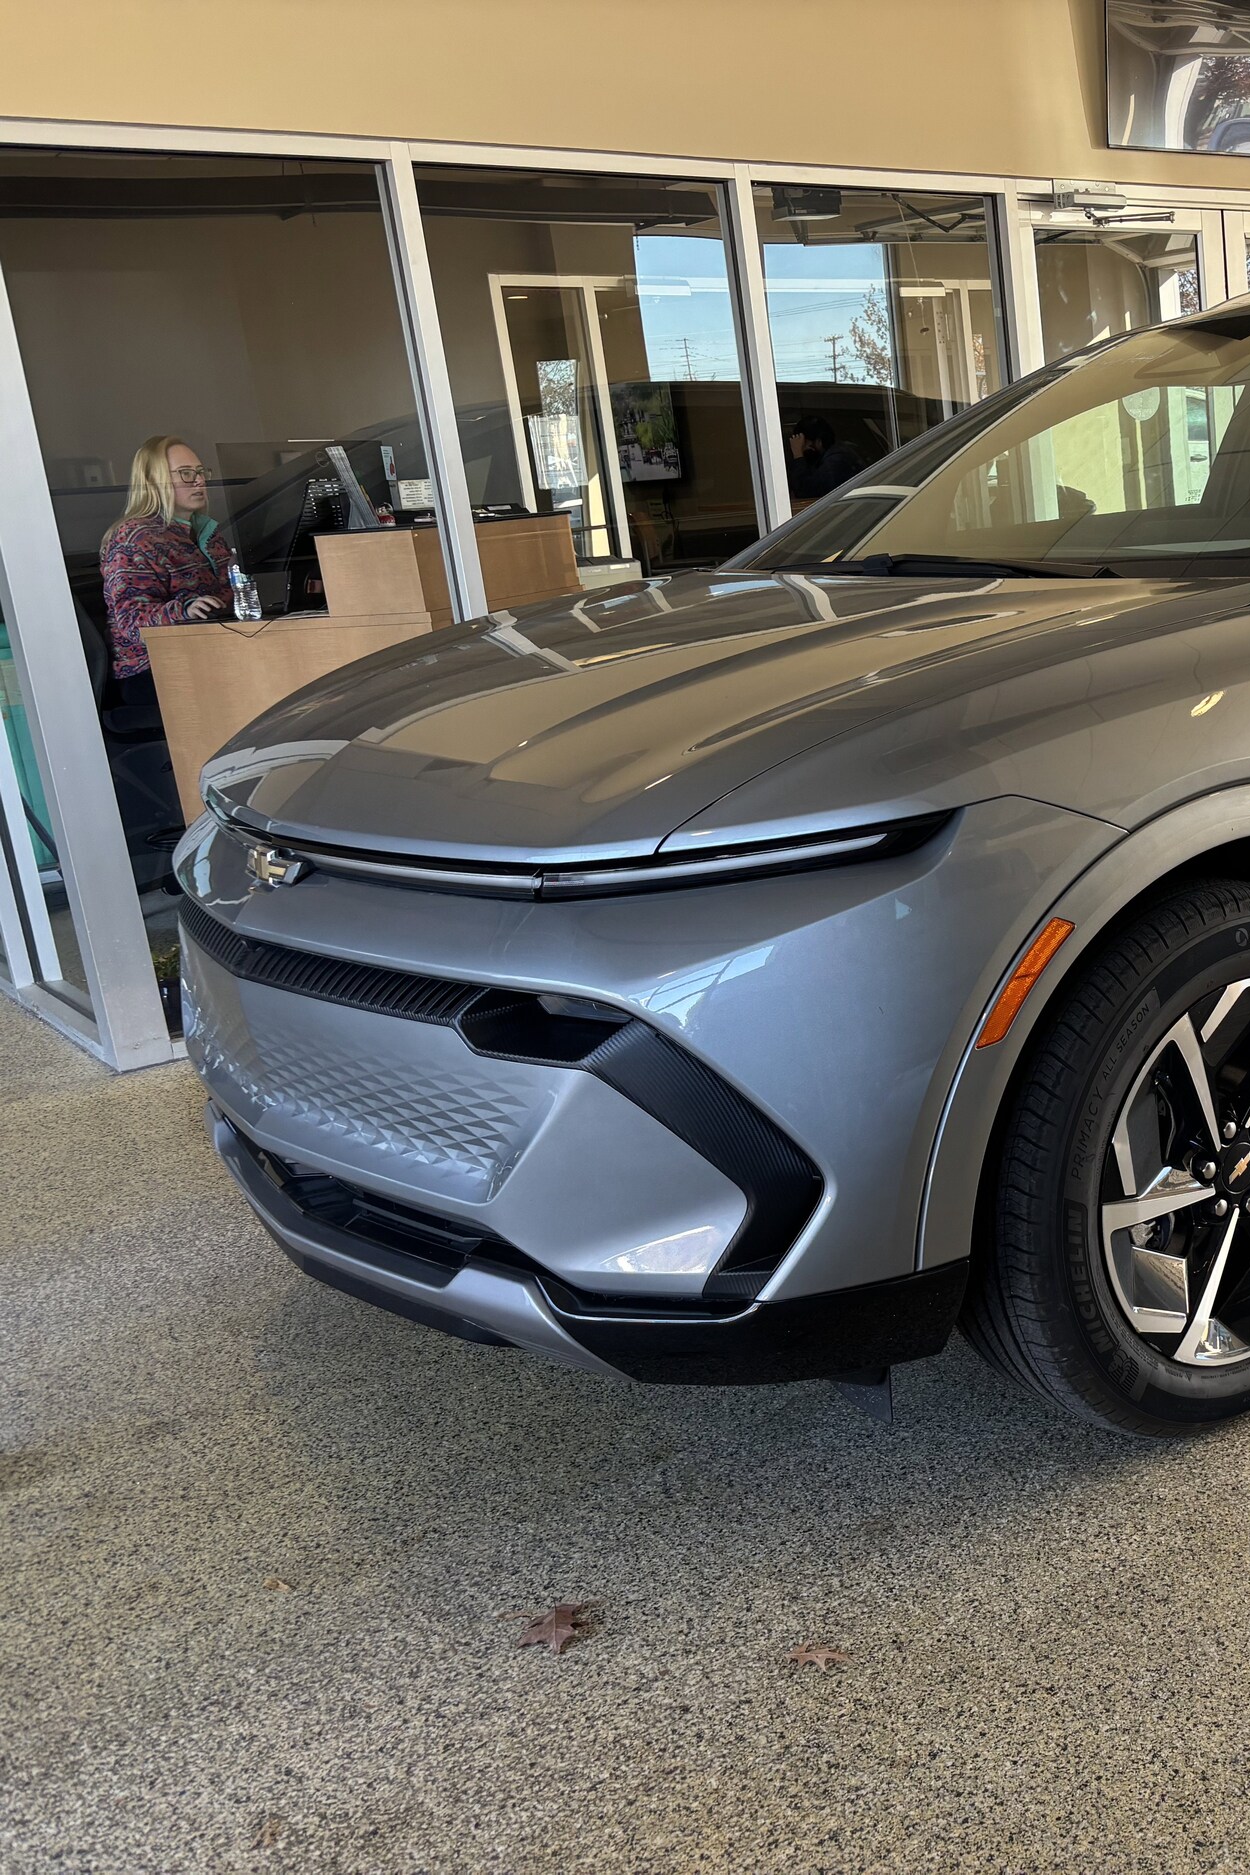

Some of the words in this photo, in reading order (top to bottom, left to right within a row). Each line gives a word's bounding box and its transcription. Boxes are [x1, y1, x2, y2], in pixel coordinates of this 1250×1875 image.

[1070, 1085, 1104, 1181] PRIMACY
[1102, 1056, 1118, 1085] ALL
[1115, 1003, 1151, 1054] SEASON
[1067, 1208, 1114, 1354] MICHELIN
